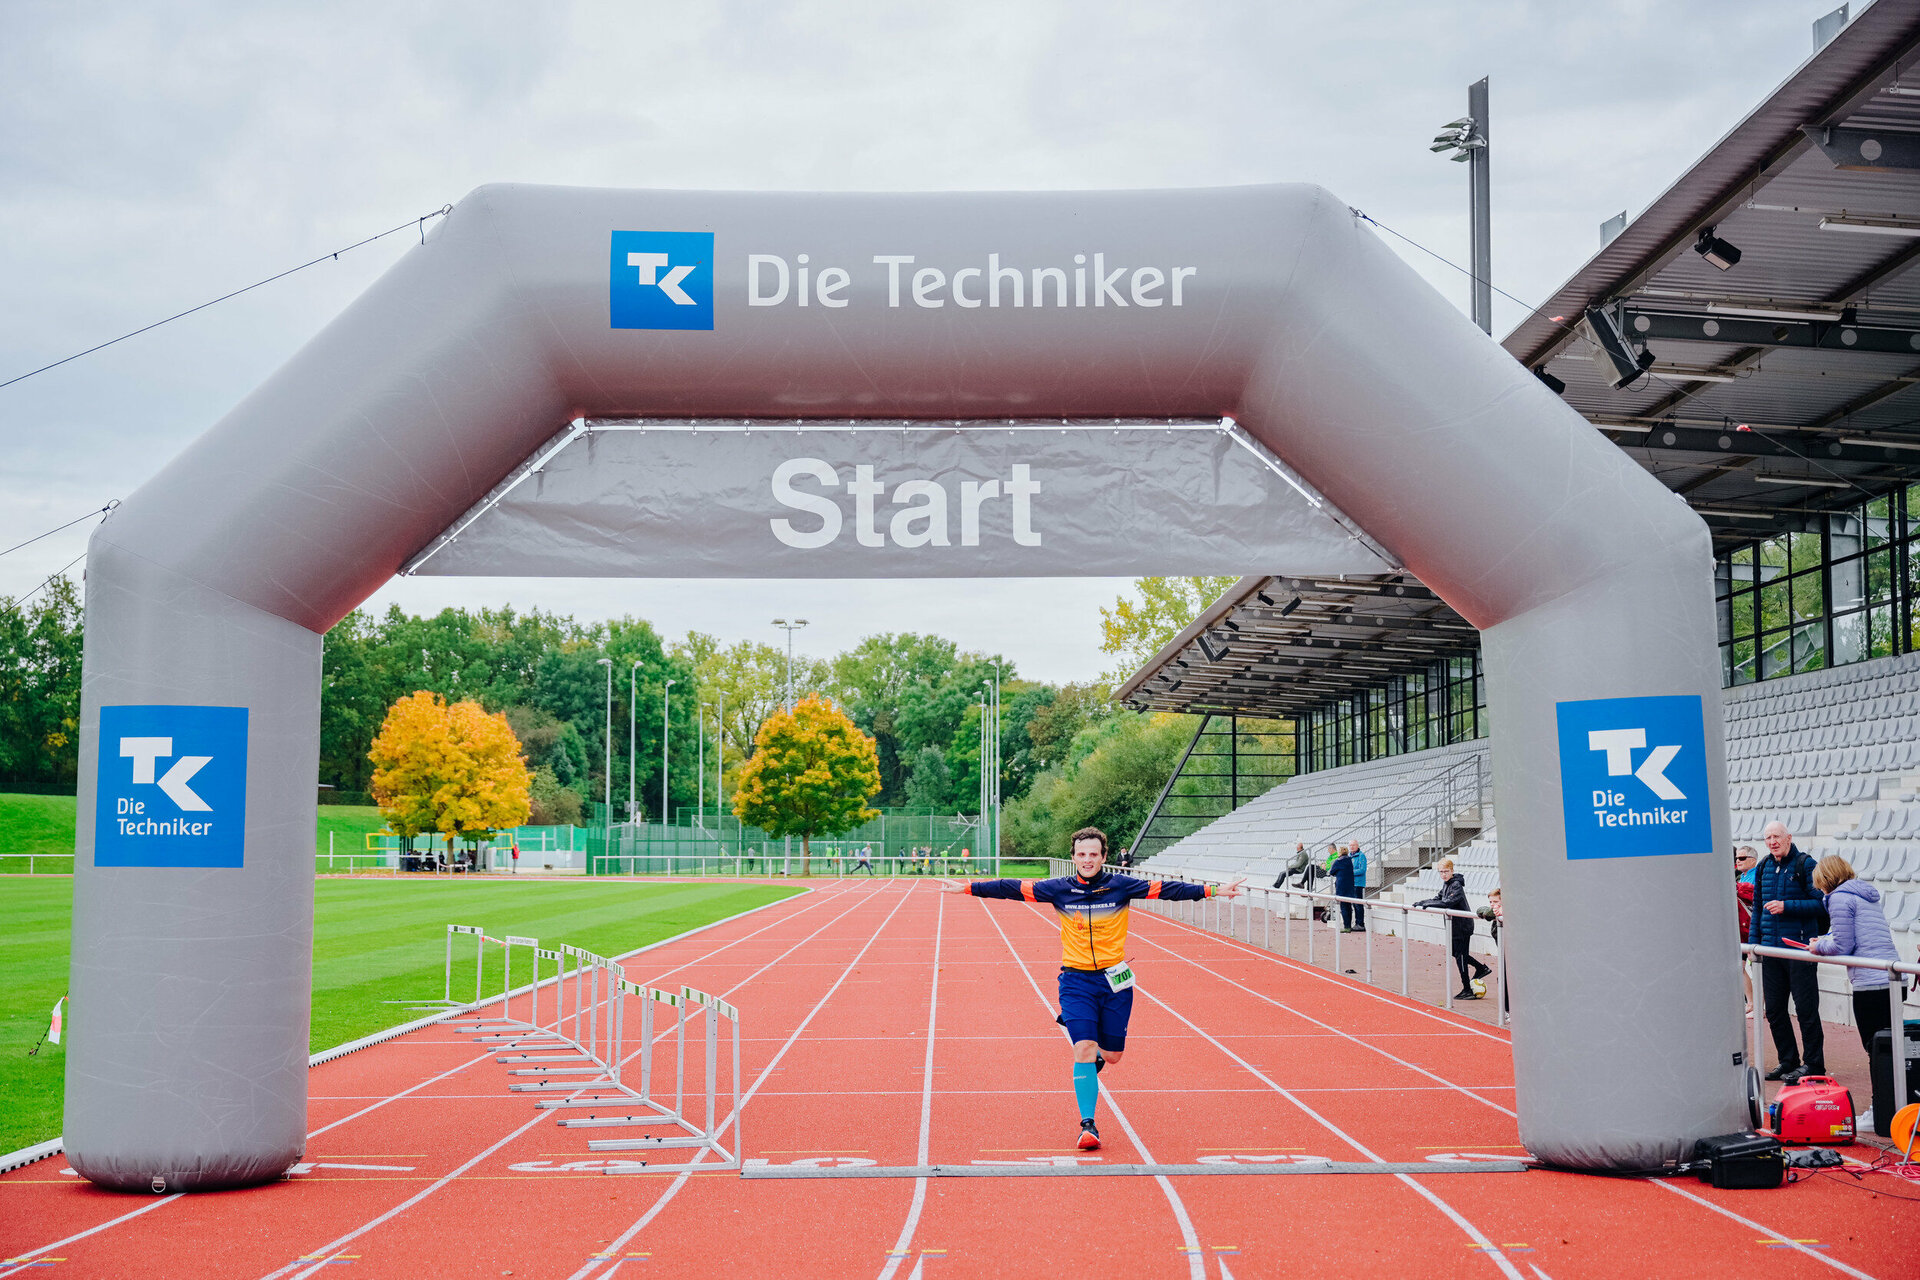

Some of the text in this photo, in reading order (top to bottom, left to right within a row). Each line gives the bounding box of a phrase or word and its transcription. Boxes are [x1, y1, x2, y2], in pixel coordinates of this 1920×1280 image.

[627, 252, 697, 305] TK
[747, 252, 1197, 308] Die Techniker
[769, 457, 1042, 549] Start
[119, 737, 214, 812] TK
[1588, 728, 1688, 801] TK
[117, 798, 145, 815] Die
[1592, 789, 1625, 808] Die
[1594, 806, 1689, 828] Techniker
[117, 818, 213, 836] Techniker
